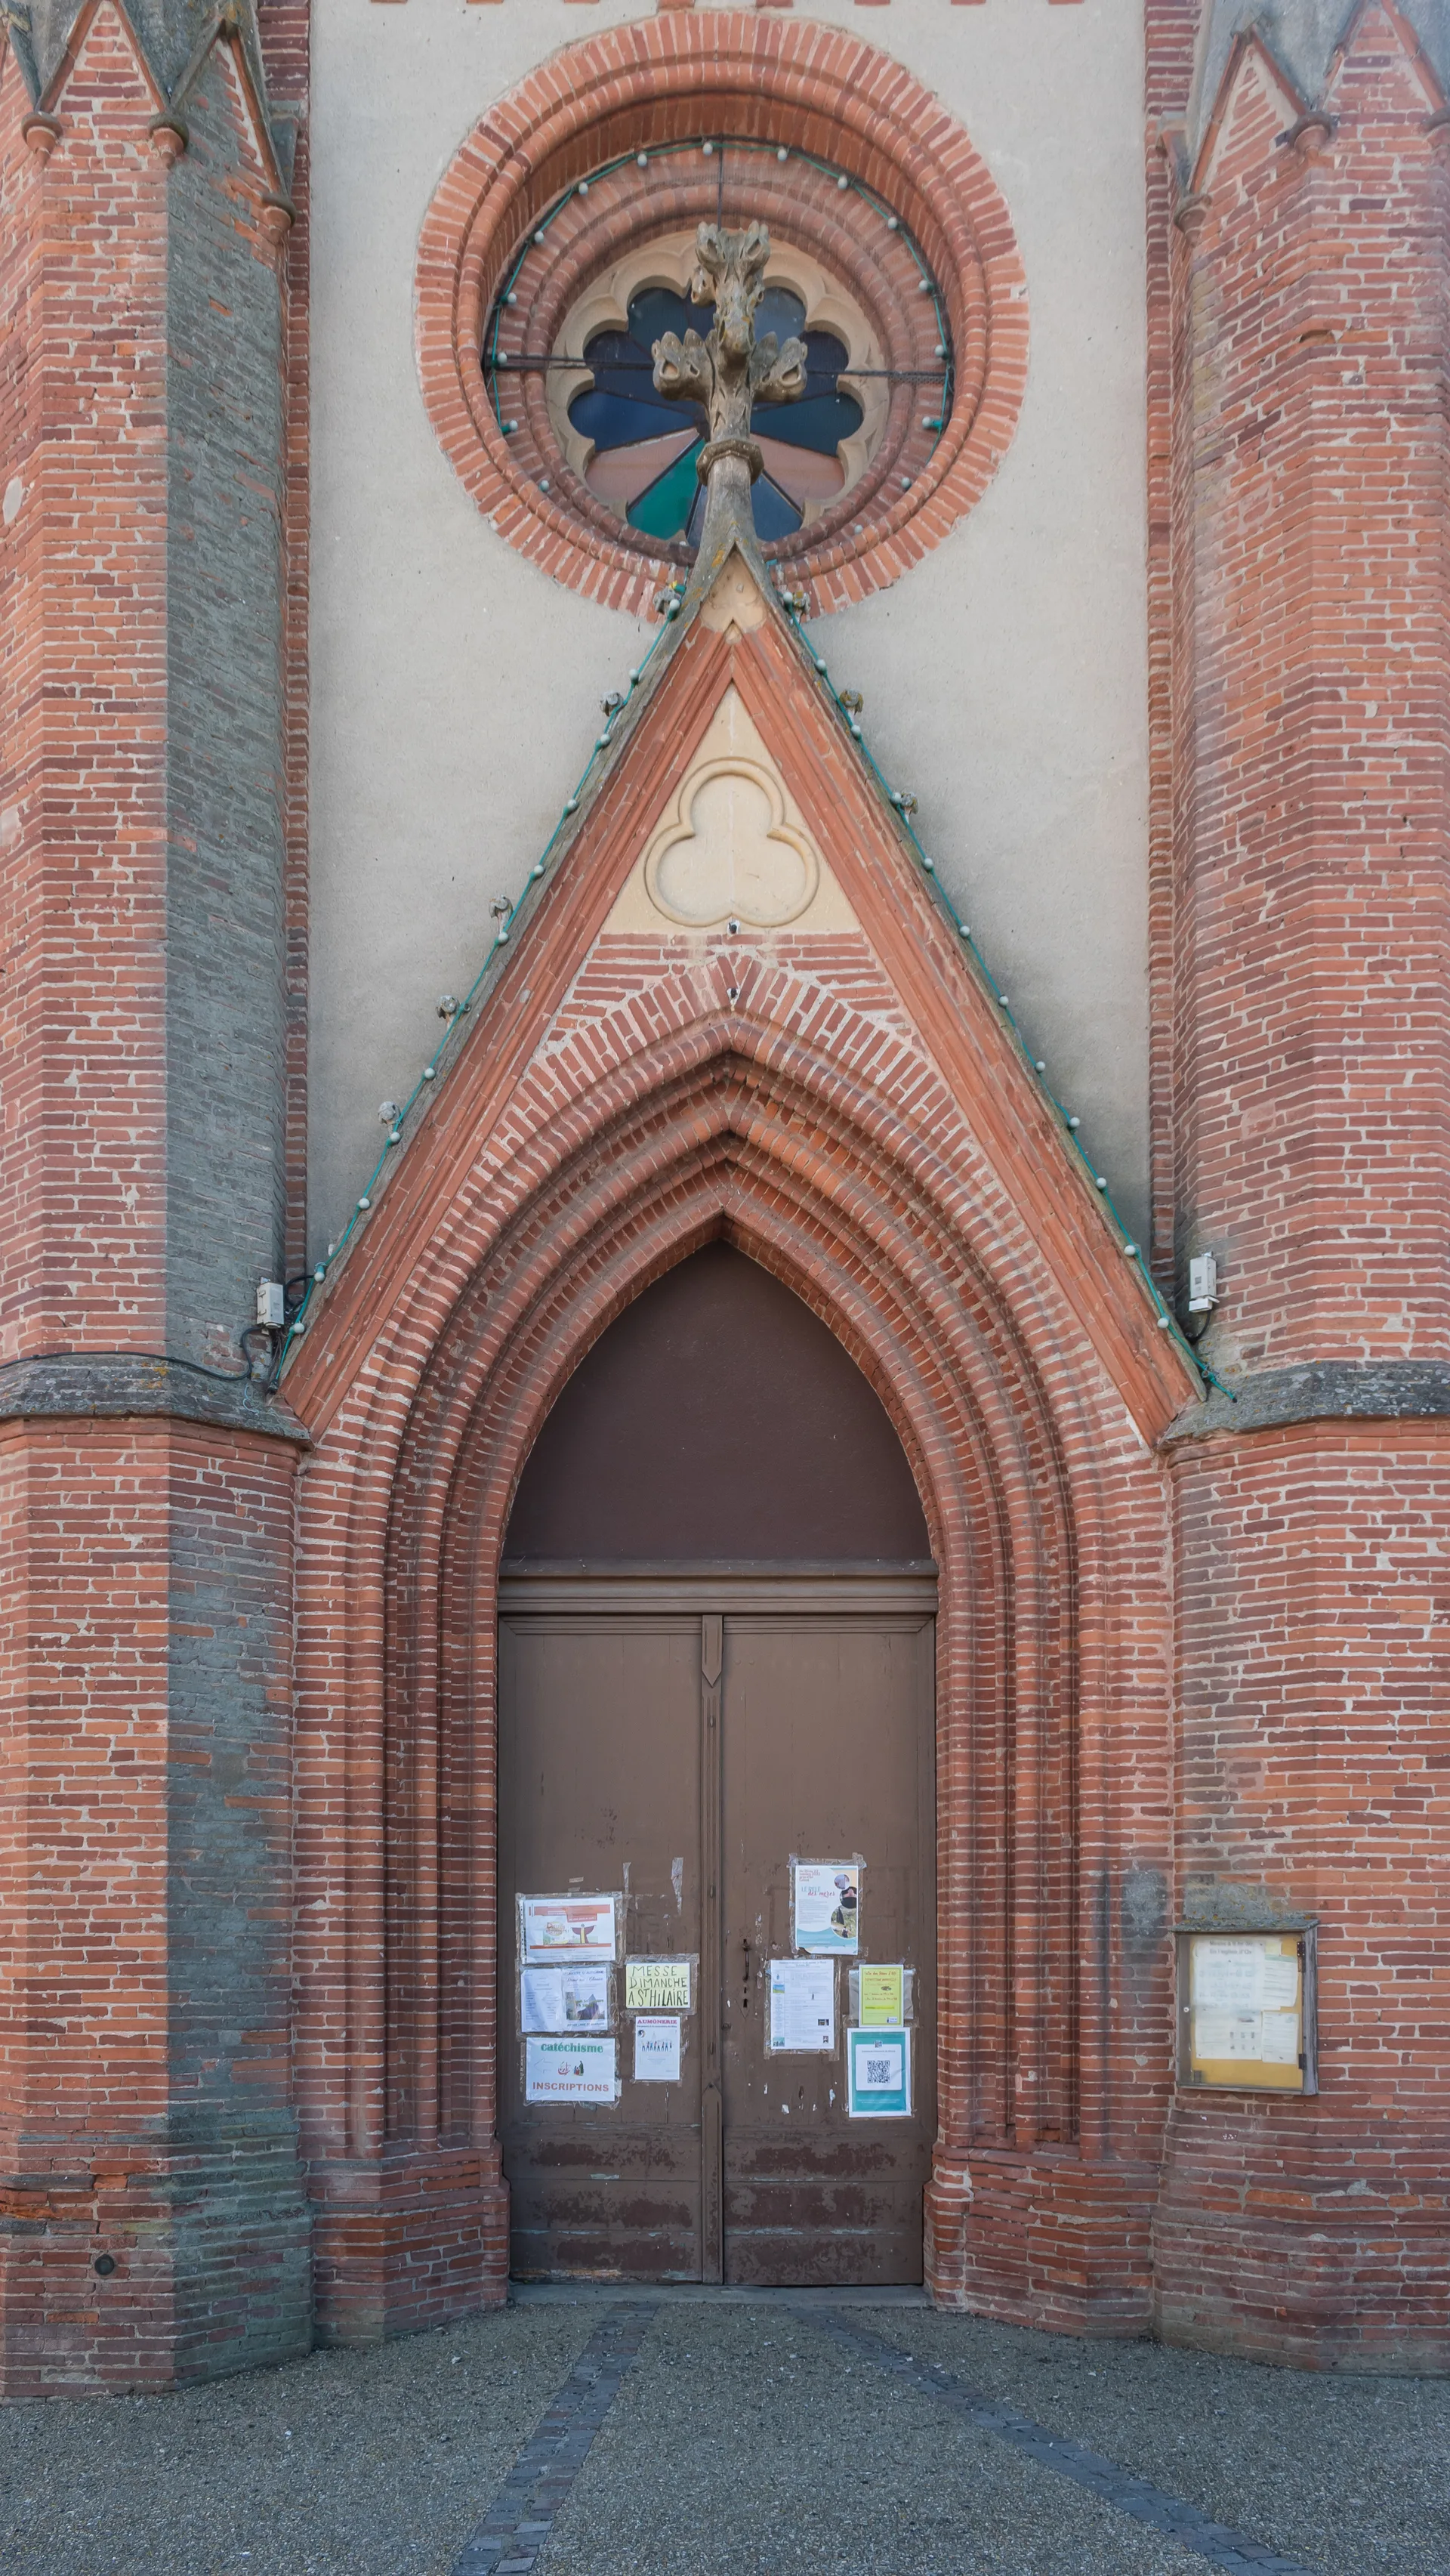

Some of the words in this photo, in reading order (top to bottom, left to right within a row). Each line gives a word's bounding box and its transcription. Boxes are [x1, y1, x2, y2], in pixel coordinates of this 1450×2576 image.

[632, 1966, 677, 1977] MESSE
[629, 1976, 687, 1989] DIMANCHE
[628, 1991, 634, 2006] A
[541, 2042, 603, 2053] catéchisme
[532, 2082, 609, 2092] INSCRIPTIONS
